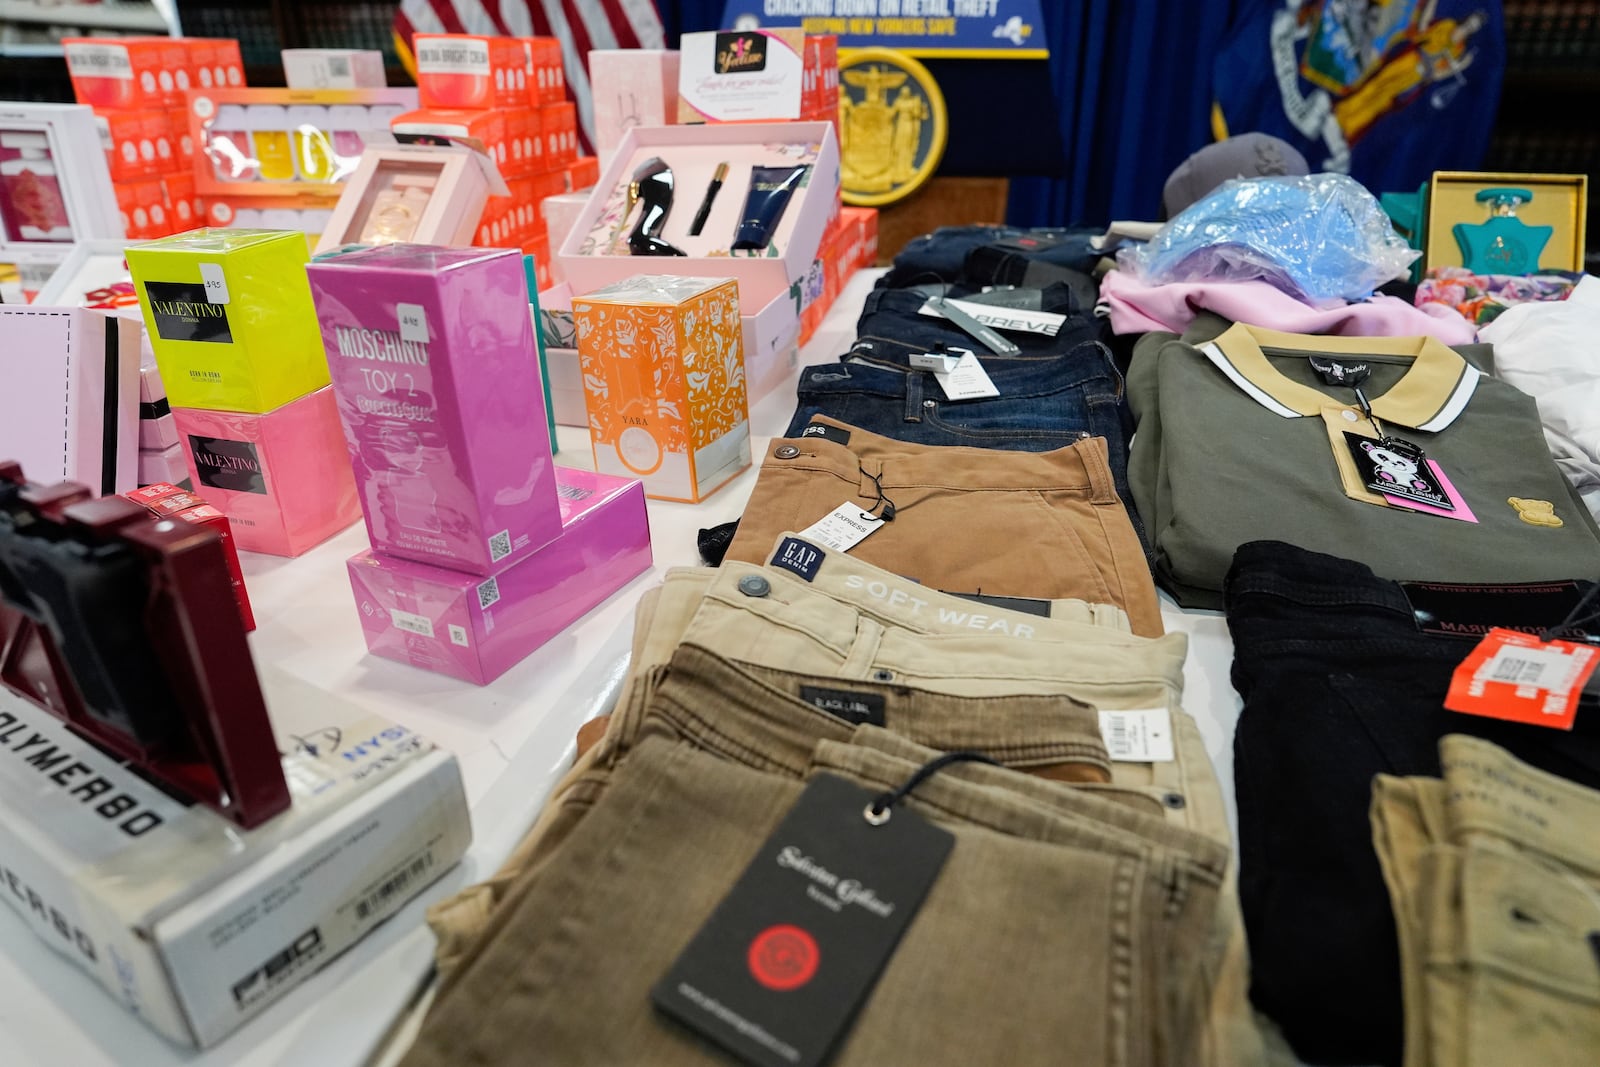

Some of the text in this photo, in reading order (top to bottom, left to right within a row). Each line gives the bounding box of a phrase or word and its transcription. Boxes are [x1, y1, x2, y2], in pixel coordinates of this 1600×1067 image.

[153, 300, 223, 319] VALENTINO
[974, 314, 1060, 334] BREVE
[335, 325, 429, 366] MOSCHINO
[1344, 364, 1367, 374] Teddy
[360, 368, 418, 397] TOY 2
[622, 415, 648, 426] YARA
[195, 451, 258, 472] VALENTINO
[833, 512, 868, 533] EXPRESS
[784, 541, 818, 567] GAP
[781, 557, 809, 574] DENIM
[845, 574, 1035, 639] SOFT WEAR
